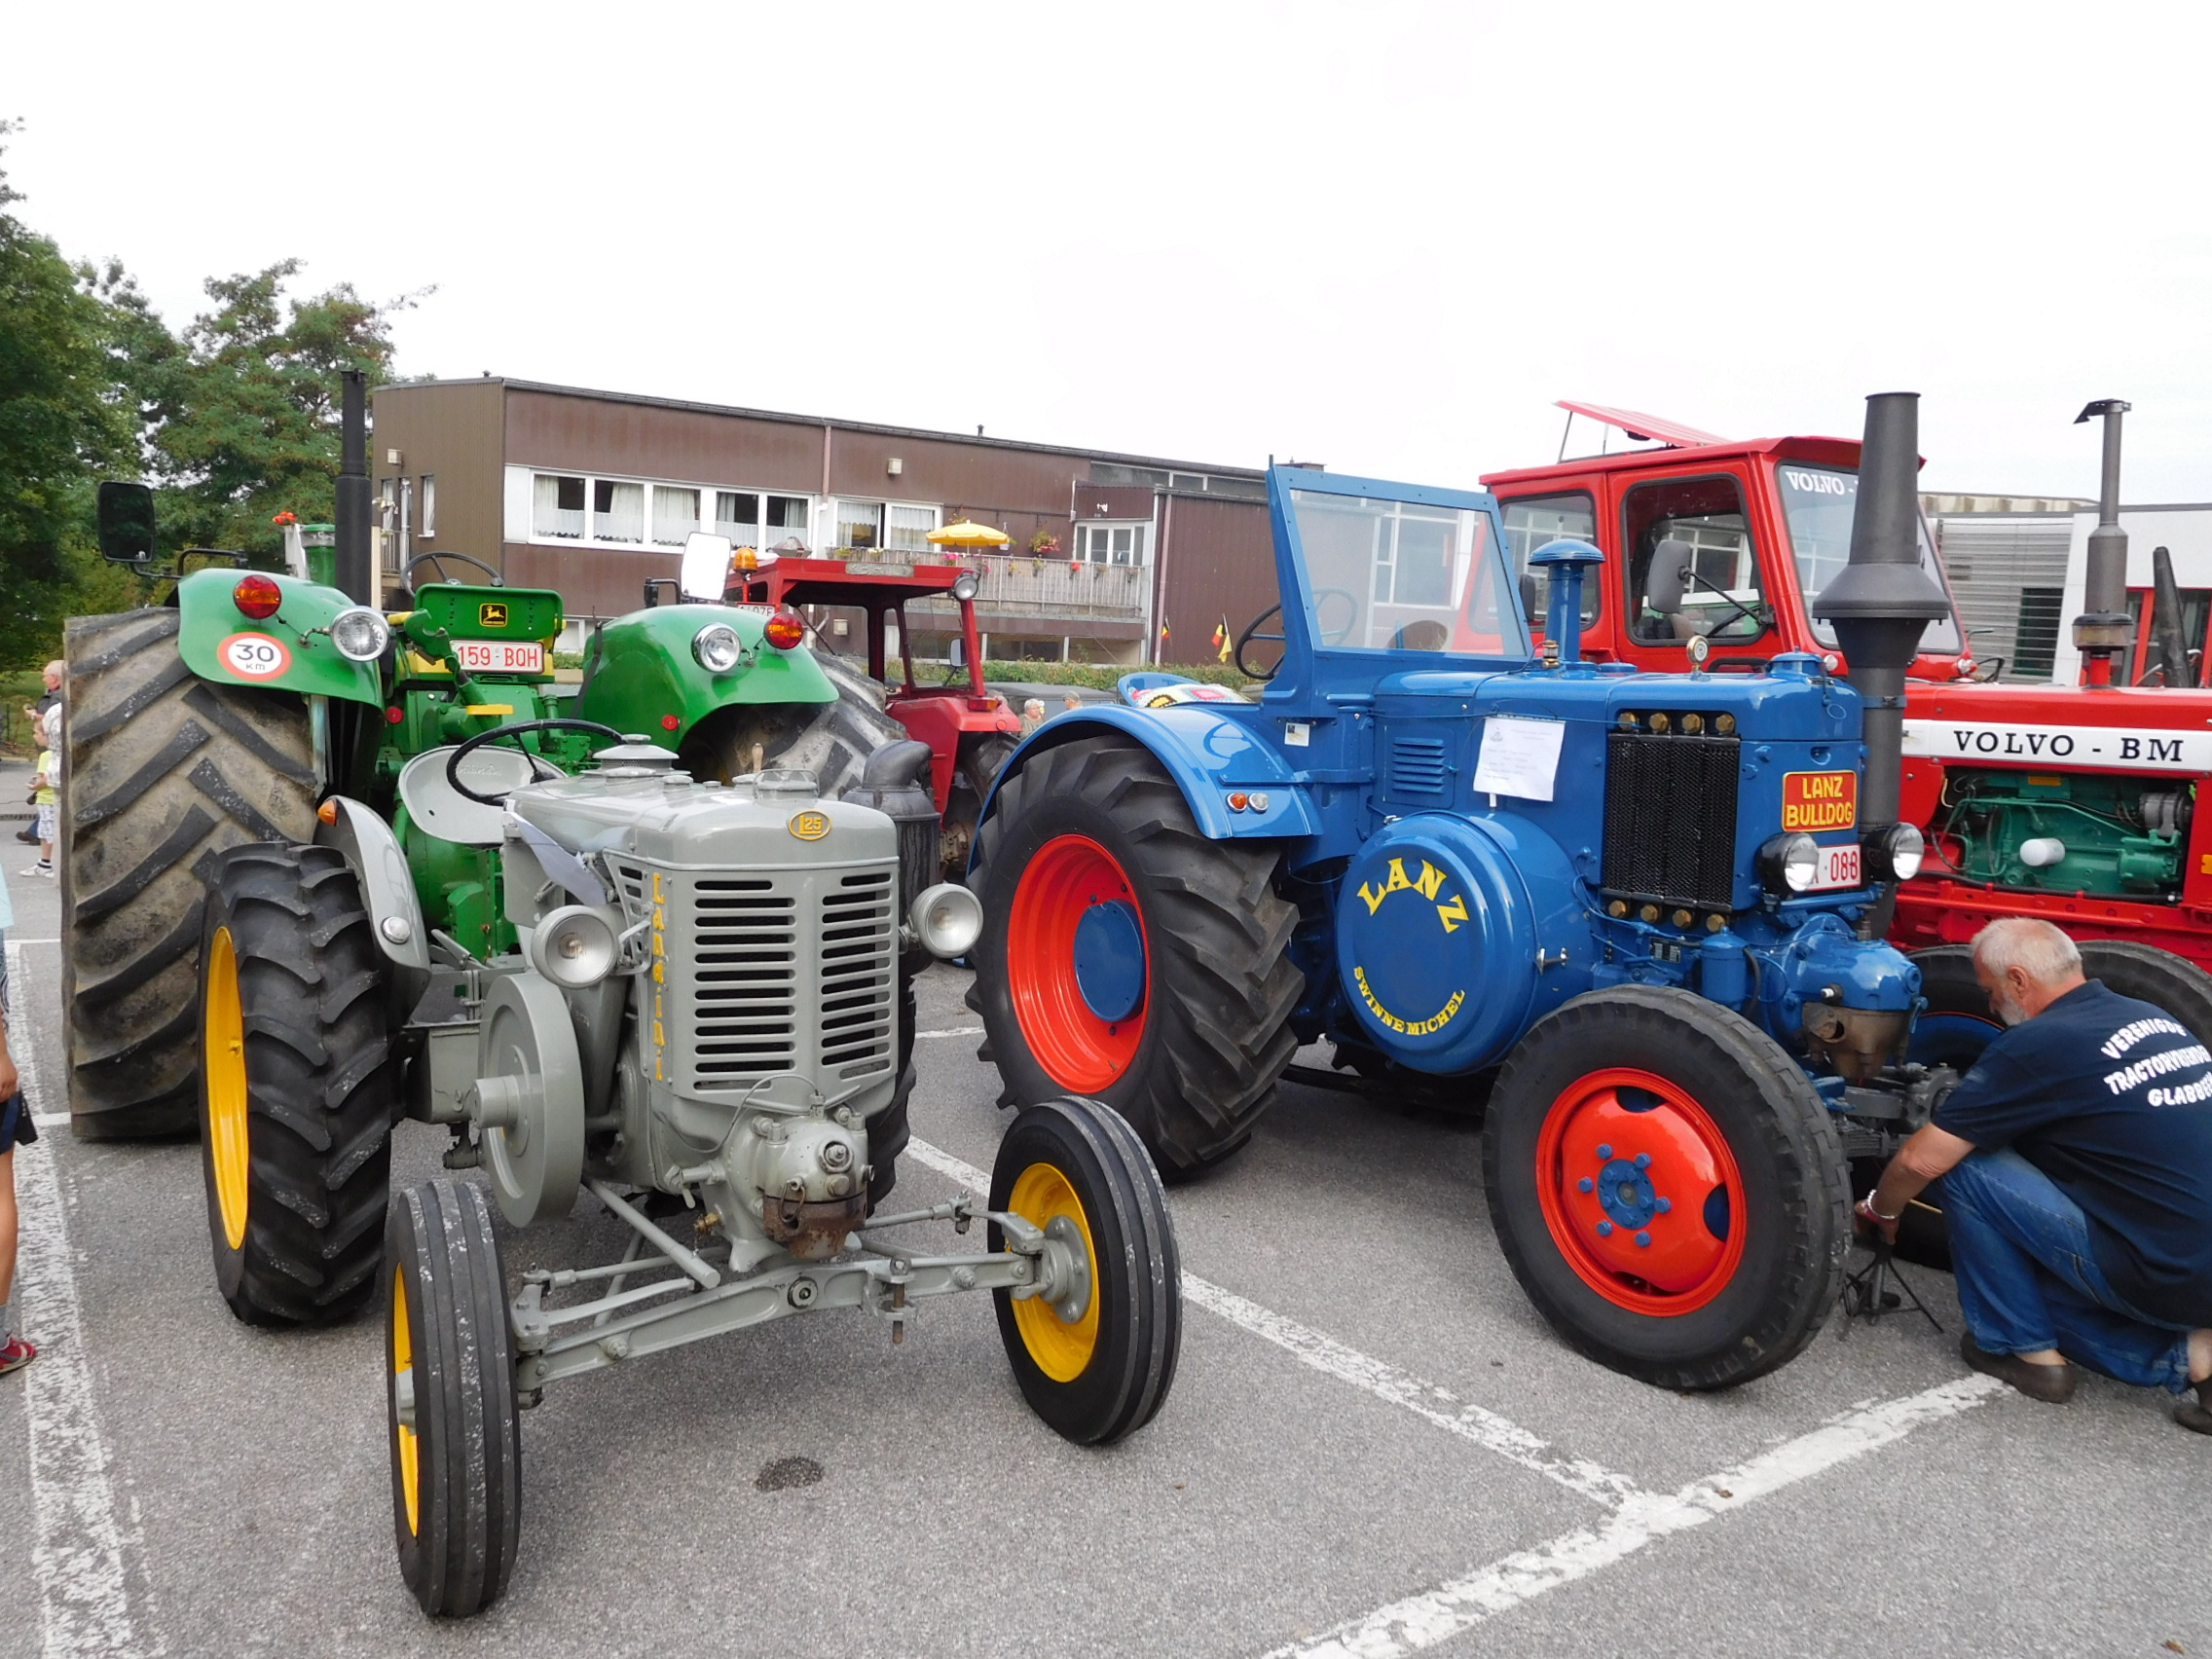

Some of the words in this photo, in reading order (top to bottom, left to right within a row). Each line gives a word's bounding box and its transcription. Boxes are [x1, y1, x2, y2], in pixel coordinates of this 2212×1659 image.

[1785, 471, 1845, 496] VOLVO
[236, 644, 274, 662] 30
[458, 646, 491, 666] 159
[504, 647, 537, 667] BQH
[1954, 730, 2074, 756] VOLVO
[2120, 737, 2184, 762] BM
[1802, 776, 1843, 799] LANZ
[1787, 802, 1853, 827] BULLDOG
[1357, 858, 1469, 934] LANZ
